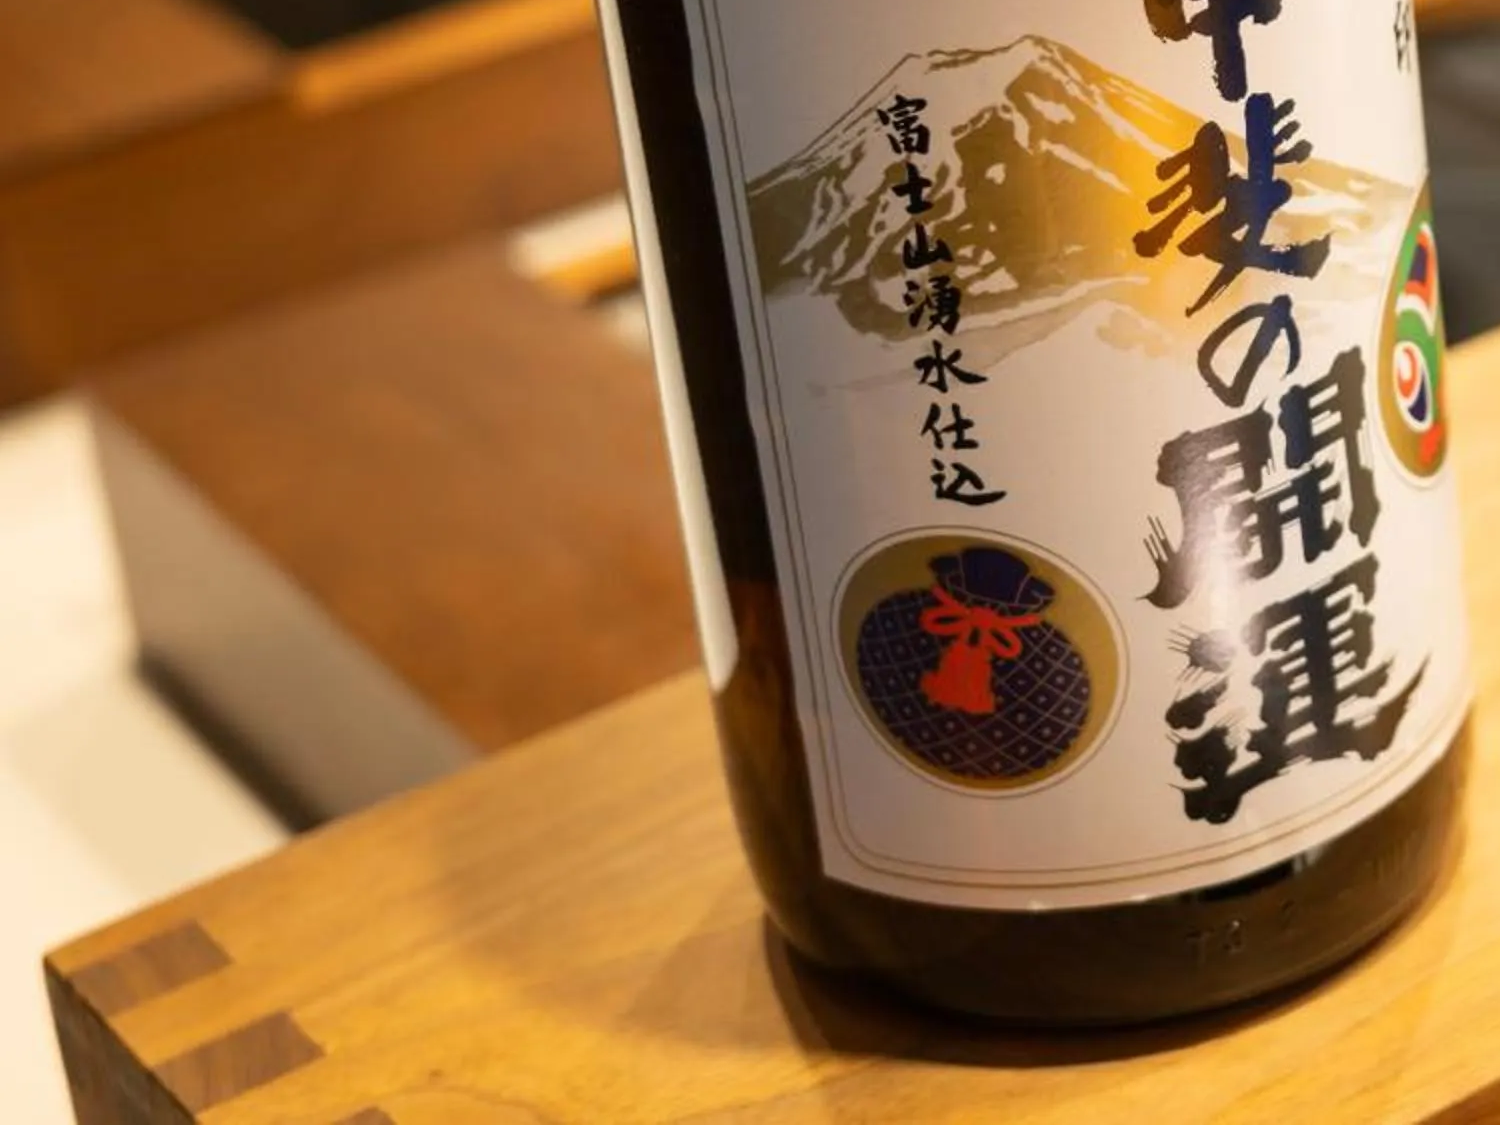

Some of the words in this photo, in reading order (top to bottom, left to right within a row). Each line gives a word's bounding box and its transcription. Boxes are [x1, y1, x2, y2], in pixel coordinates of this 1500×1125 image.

[876, 94, 1008, 507] 富士山湧水仕込
